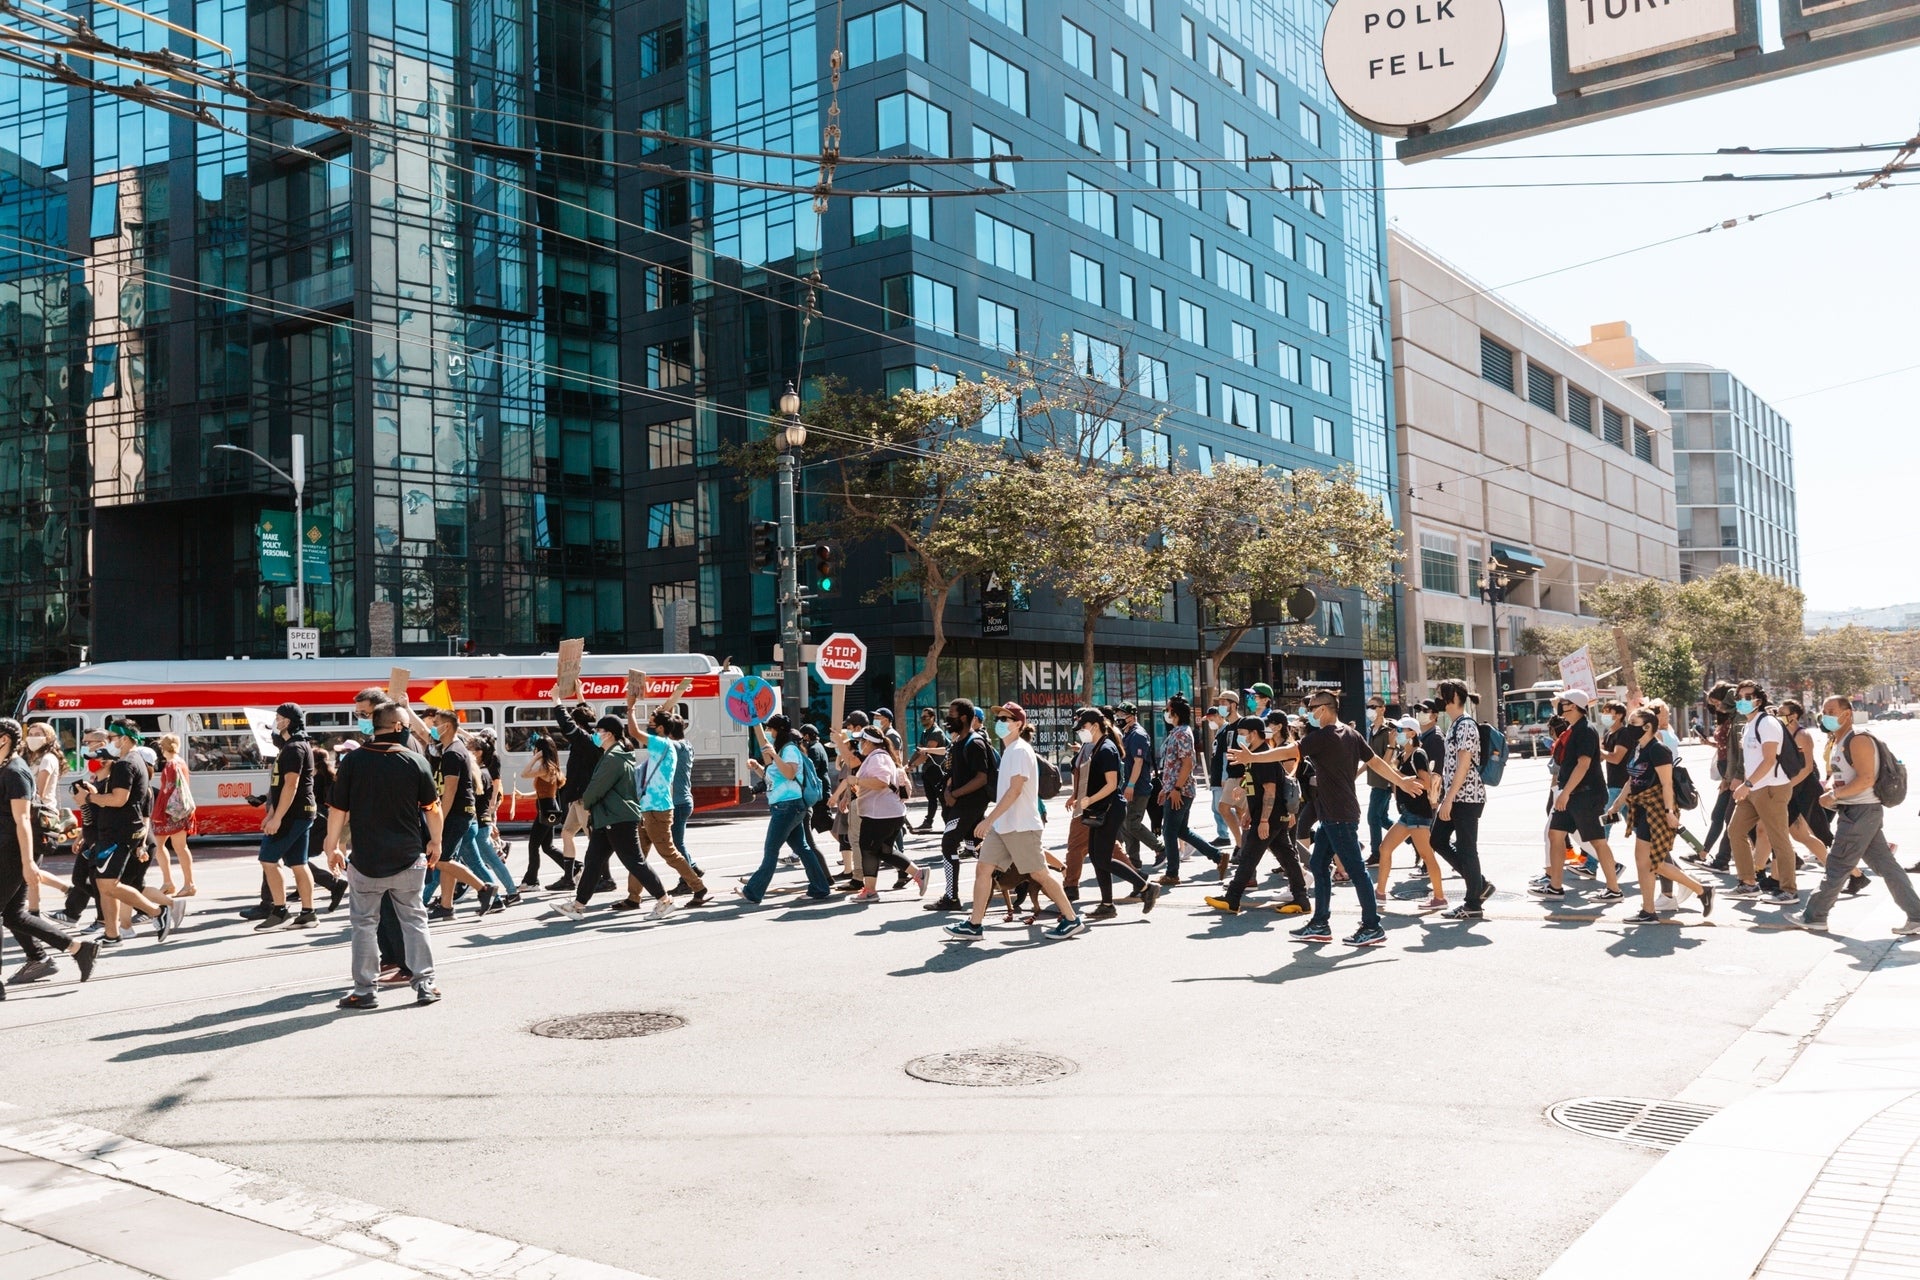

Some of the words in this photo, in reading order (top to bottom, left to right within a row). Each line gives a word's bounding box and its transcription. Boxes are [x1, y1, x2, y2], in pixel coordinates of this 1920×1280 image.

[1364, 0, 1455, 34] POLK
[1369, 47, 1455, 79] FELL
[262, 533, 279, 541] MAKE
[262, 541, 281, 549] POLICY
[983, 625, 1009, 633] LEASING
[826, 645, 857, 657] STOP
[821, 657, 861, 670] RACISM
[1021, 660, 1084, 690] NEMA
[581, 681, 621, 694] Clean
[58, 699, 81, 707] 8767
[1022, 692, 1030, 706] IS
[1031, 692, 1053, 706] NOW
[1062, 708, 1073, 717] TWO
